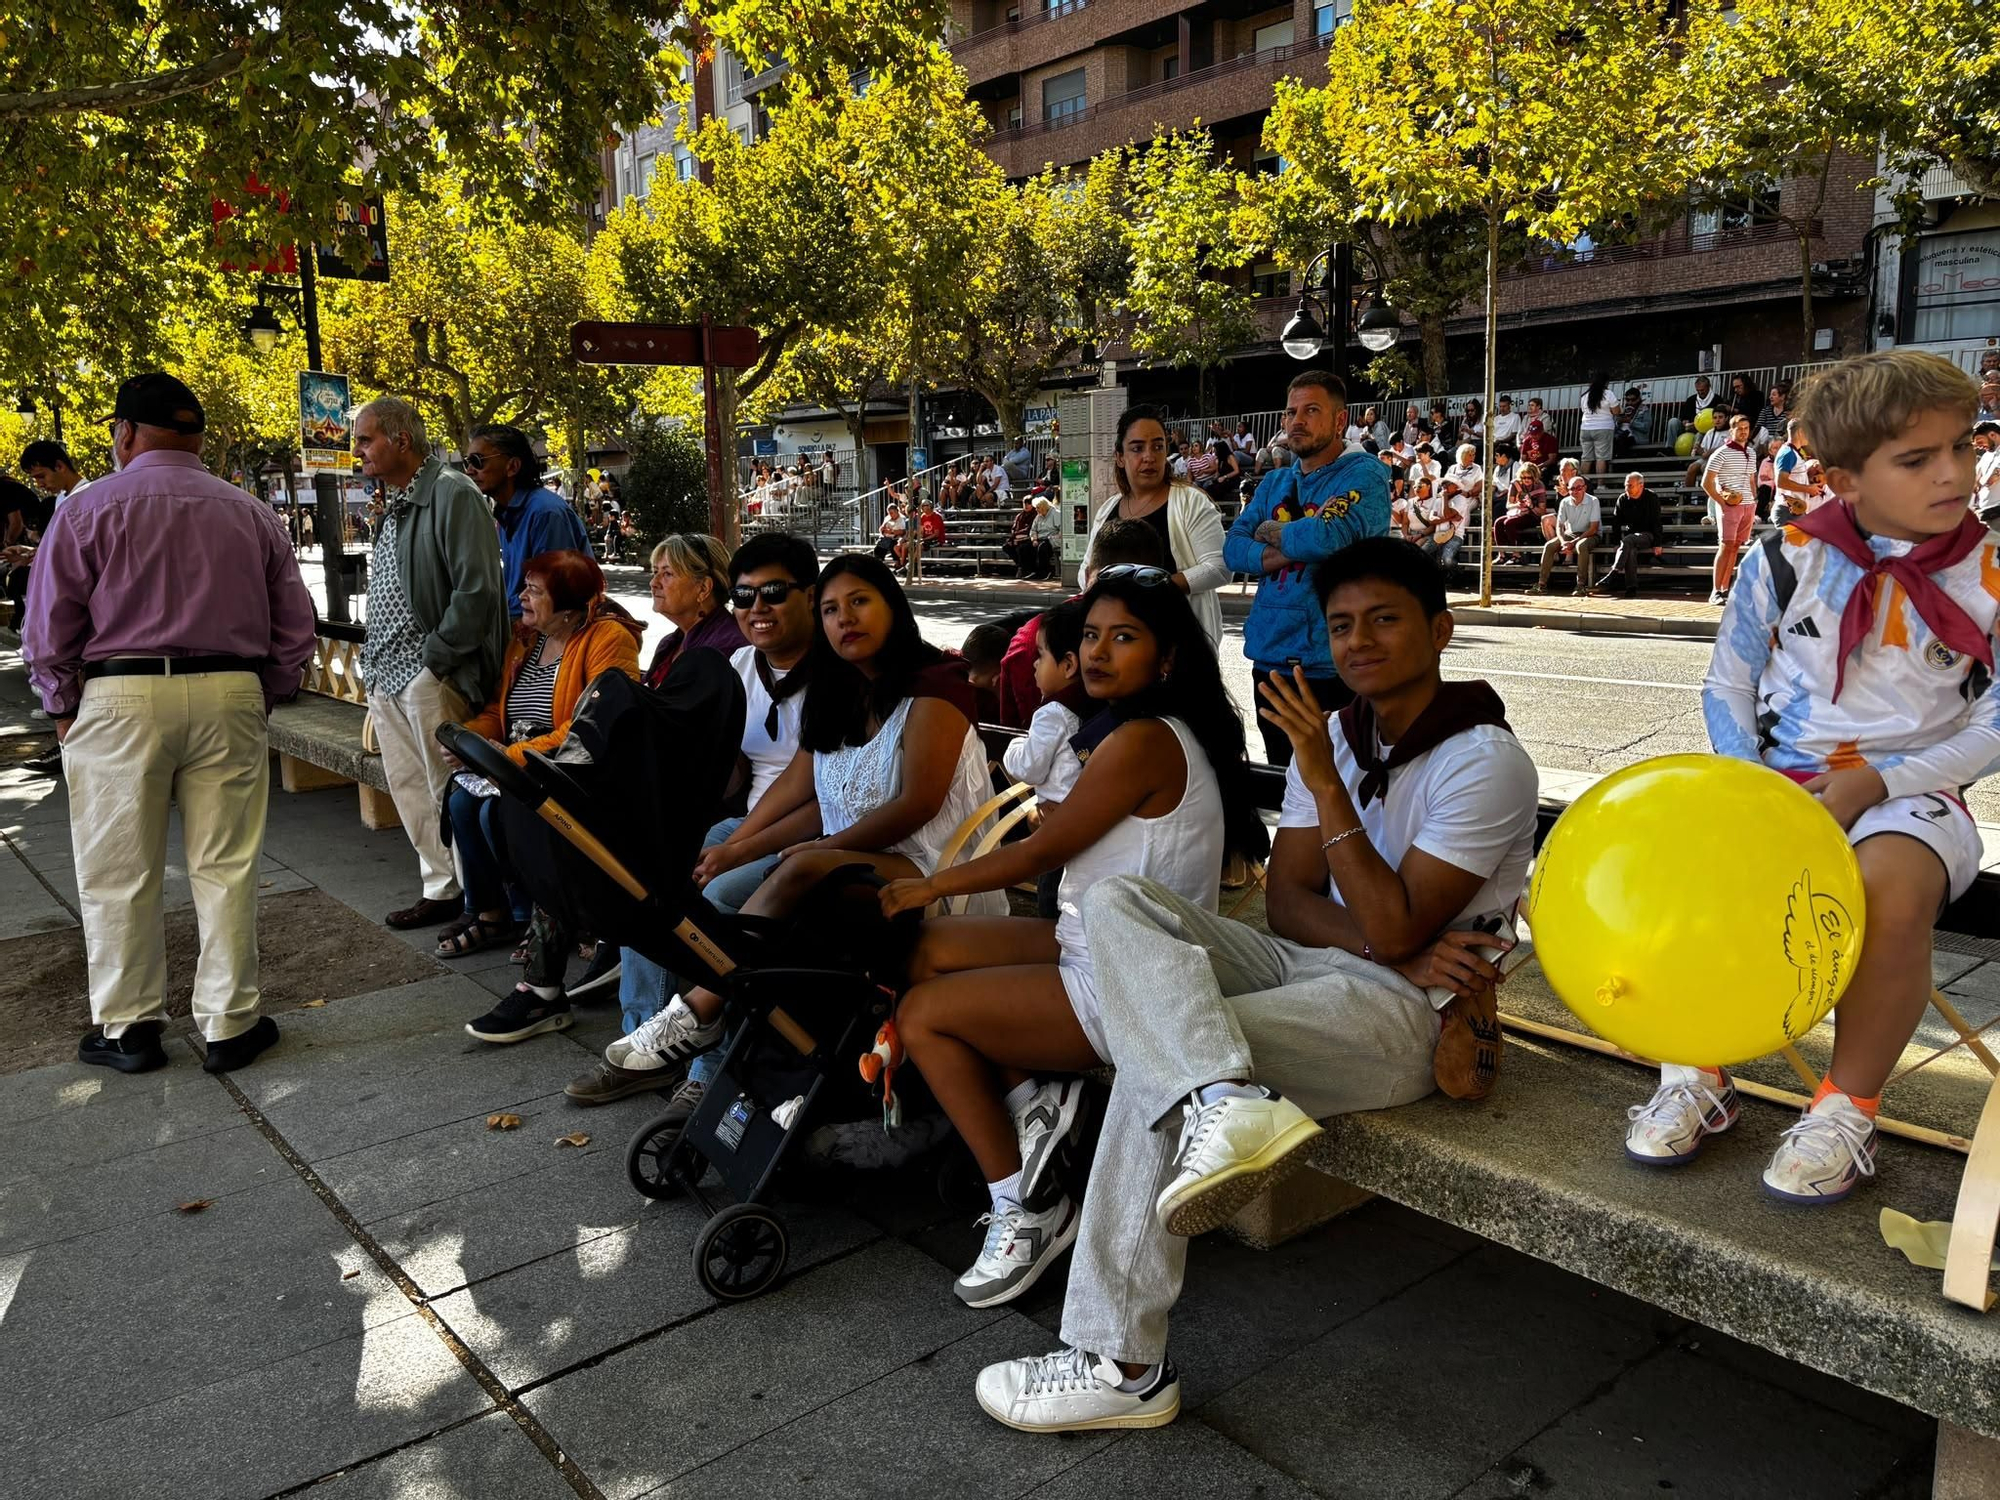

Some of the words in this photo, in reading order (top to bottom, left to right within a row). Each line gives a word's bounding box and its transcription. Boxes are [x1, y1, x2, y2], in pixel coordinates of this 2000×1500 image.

[1934, 256, 1980, 267] masculina
[1027, 409, 1039, 420] LA
[1820, 910, 1842, 941] El
[1809, 953, 1817, 965] de
[1805, 968, 1818, 1007] siempre
